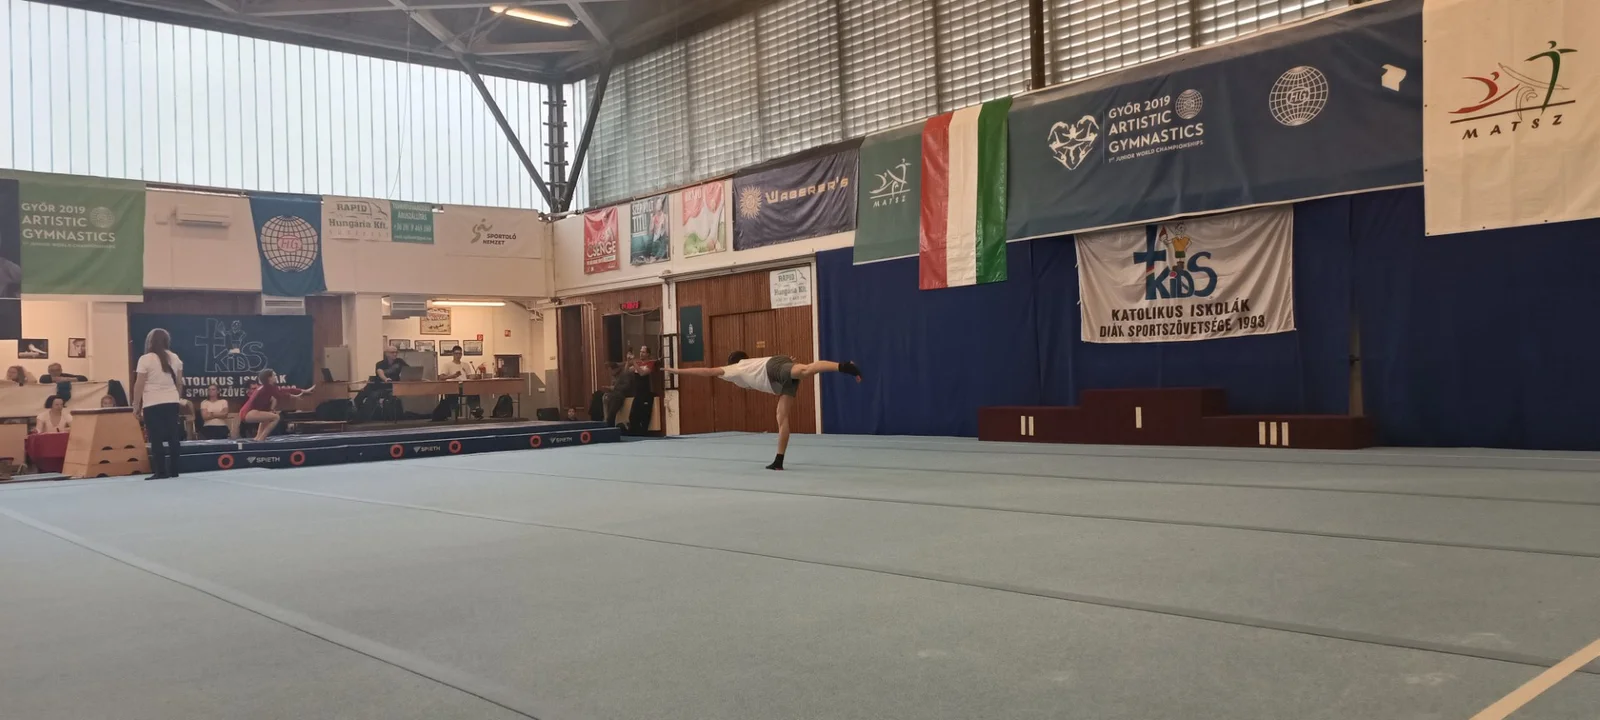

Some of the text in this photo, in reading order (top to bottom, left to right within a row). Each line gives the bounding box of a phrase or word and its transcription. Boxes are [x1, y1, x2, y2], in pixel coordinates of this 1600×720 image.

[1144, 95, 1171, 111] 2019
[1108, 110, 1172, 136] ARTISTIC
[1462, 115, 1562, 140] MATSZ
[1108, 123, 1204, 153] GYMNASTICS
[1136, 148, 1155, 158] WORLD
[1156, 140, 1204, 153] CHAMPIONSHIPS
[59, 204, 86, 214] 2019
[336, 203, 368, 212] RAPID
[873, 197, 906, 208] MATSZ
[22, 214, 88, 227] ARTISTIC
[22, 228, 116, 243] GYMNASTICS
[1111, 297, 1251, 322] KATOLIKUS ISKOLÁK
[1099, 324, 1125, 338] DIÁK
[1237, 314, 1266, 330] 1993
[256, 456, 281, 464] SPIETH
